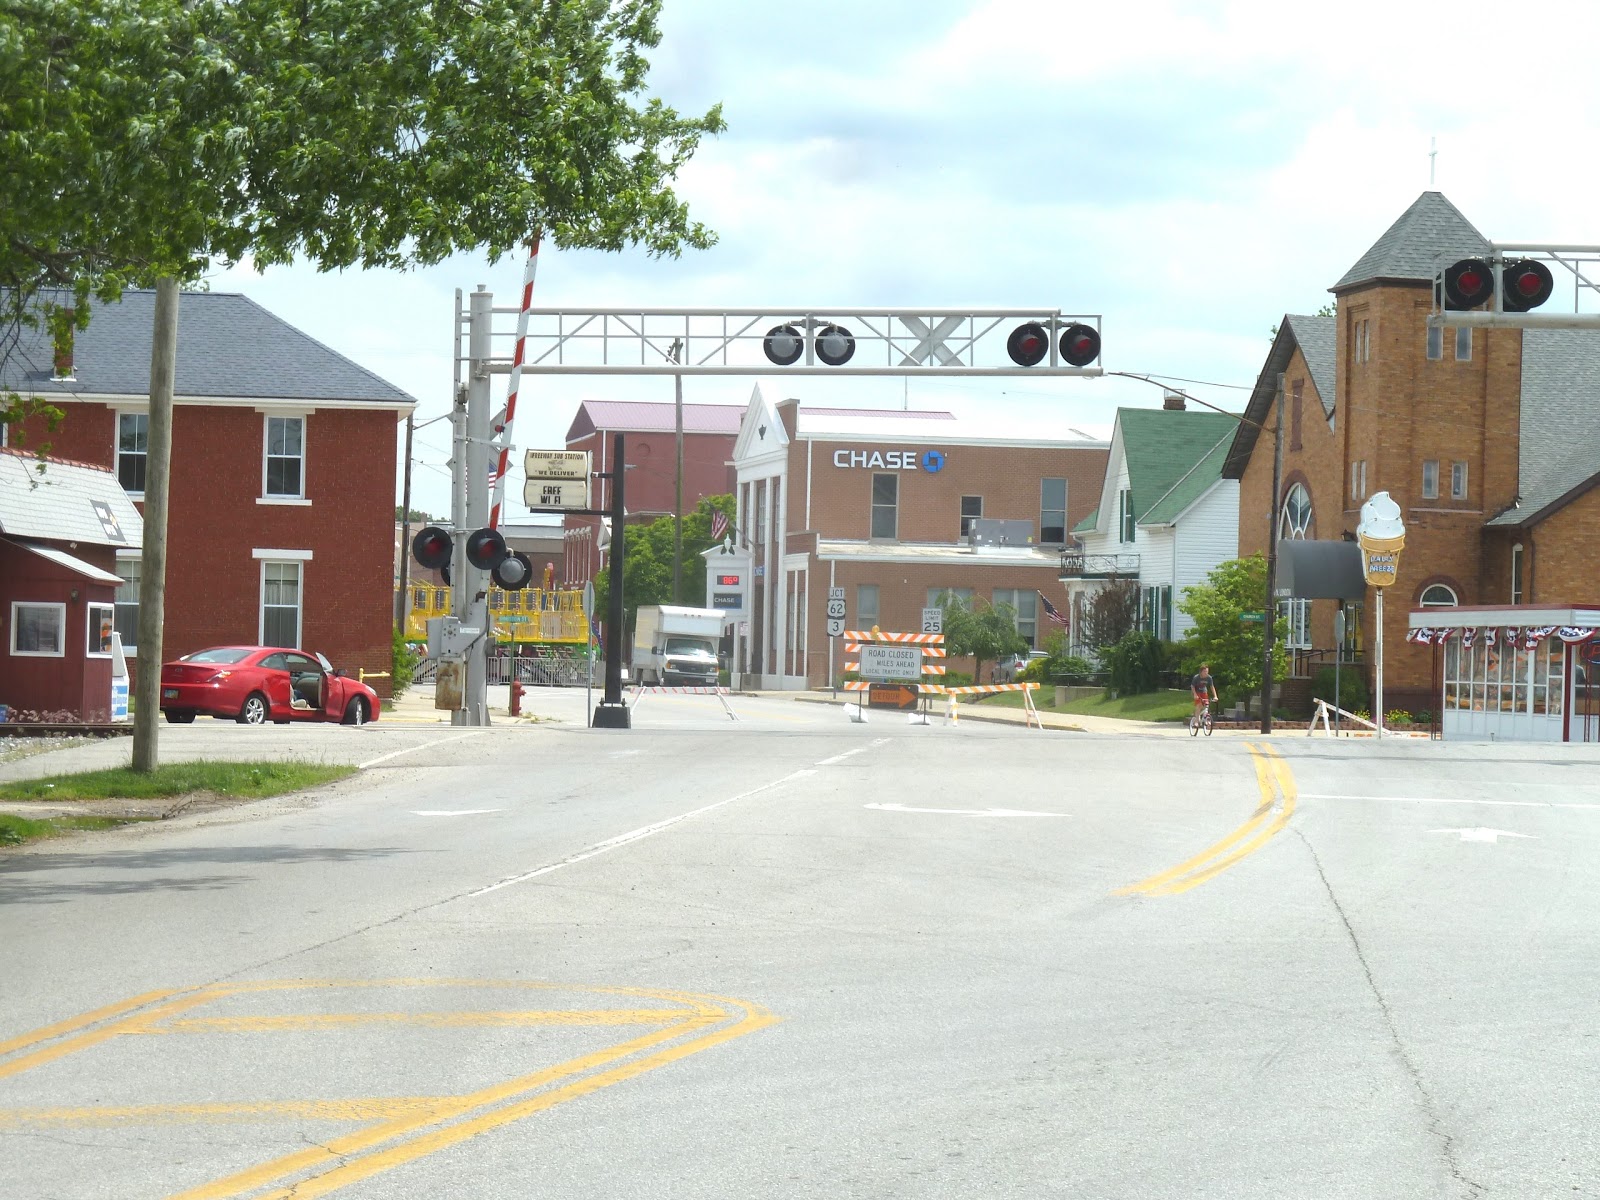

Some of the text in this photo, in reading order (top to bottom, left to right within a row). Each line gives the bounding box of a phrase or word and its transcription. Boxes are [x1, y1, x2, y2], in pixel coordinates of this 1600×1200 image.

[833, 450, 917, 469] CHASE
[830, 589, 843, 597] JCT
[830, 604, 843, 614] 62
[832, 622, 839, 632] 3
[924, 622, 940, 632] 25
[888, 651, 914, 659] CLOSED
[873, 691, 899, 700] DETOUR
